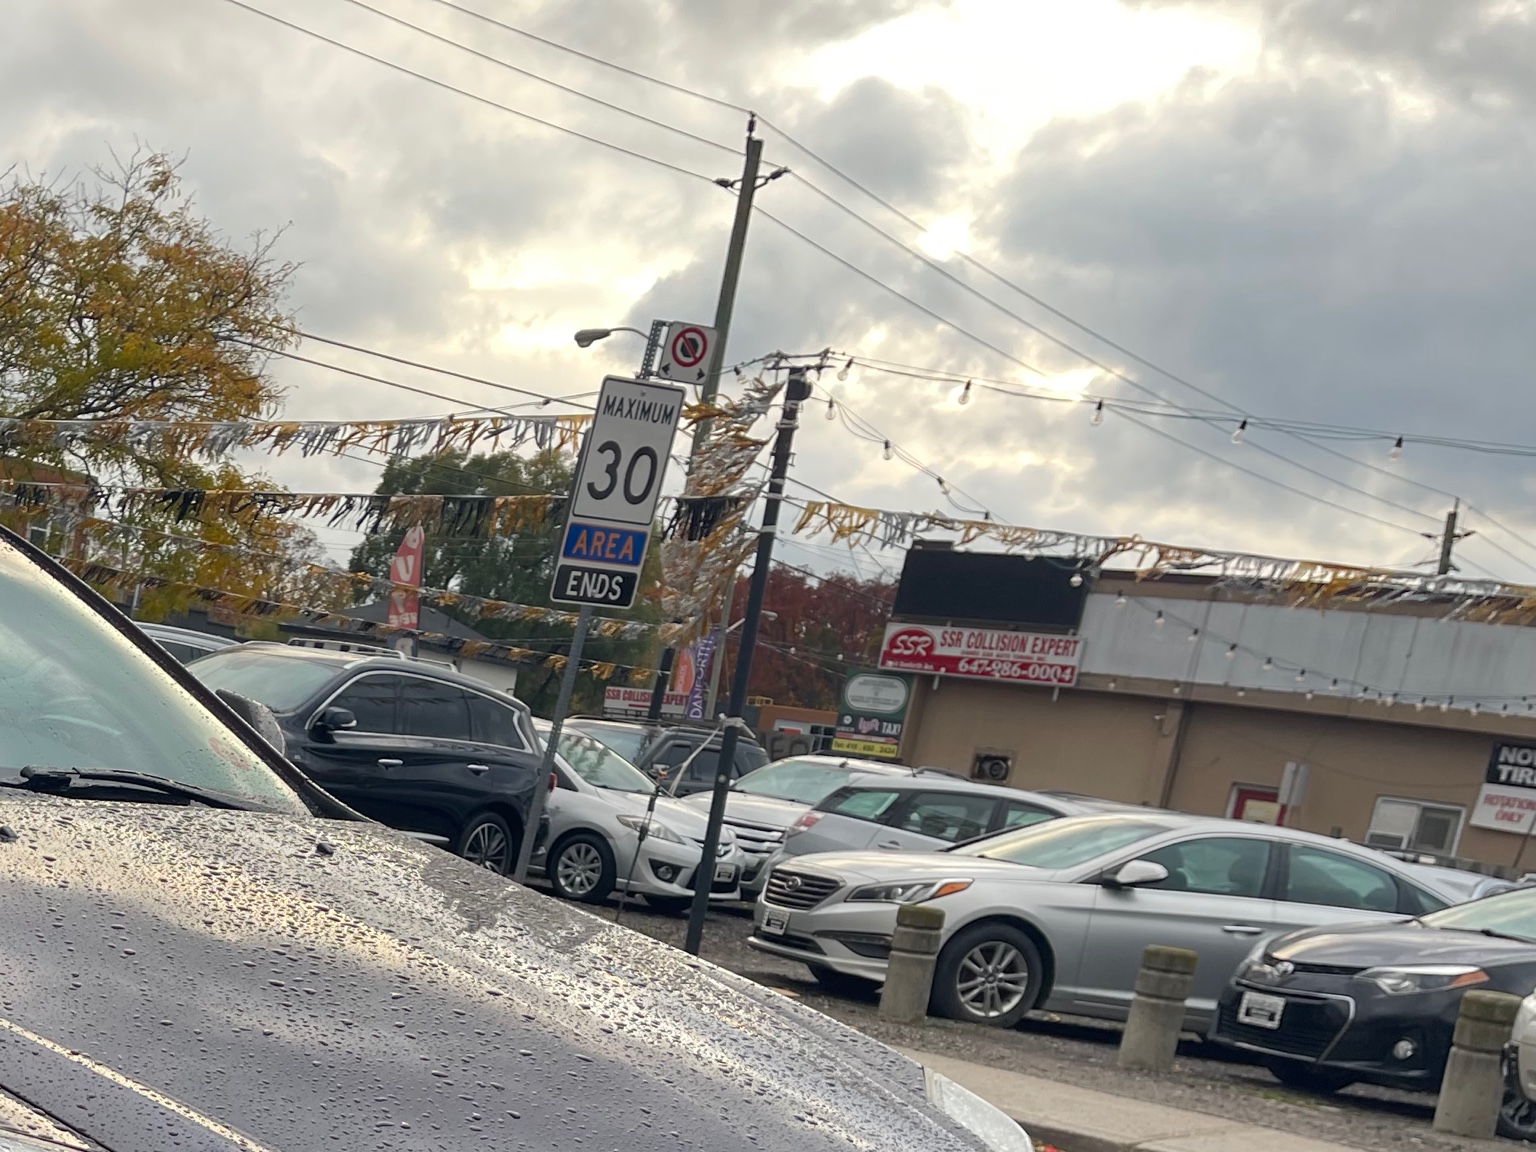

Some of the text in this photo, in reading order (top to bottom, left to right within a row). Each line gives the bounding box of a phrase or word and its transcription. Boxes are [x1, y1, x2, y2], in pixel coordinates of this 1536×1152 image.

[603, 394, 675, 425] MAXIMUM
[587, 440, 658, 505] 30
[572, 529, 634, 561] AREA
[565, 570, 624, 600] ENDS
[892, 634, 932, 656] SSR
[940, 630, 1079, 657] SSR COLLISION EXPERT
[606, 689, 621, 700] SSR
[623, 690, 652, 702] COLLISI
[1498, 746, 1536, 767] NO
[1497, 764, 1536, 785] TIR
